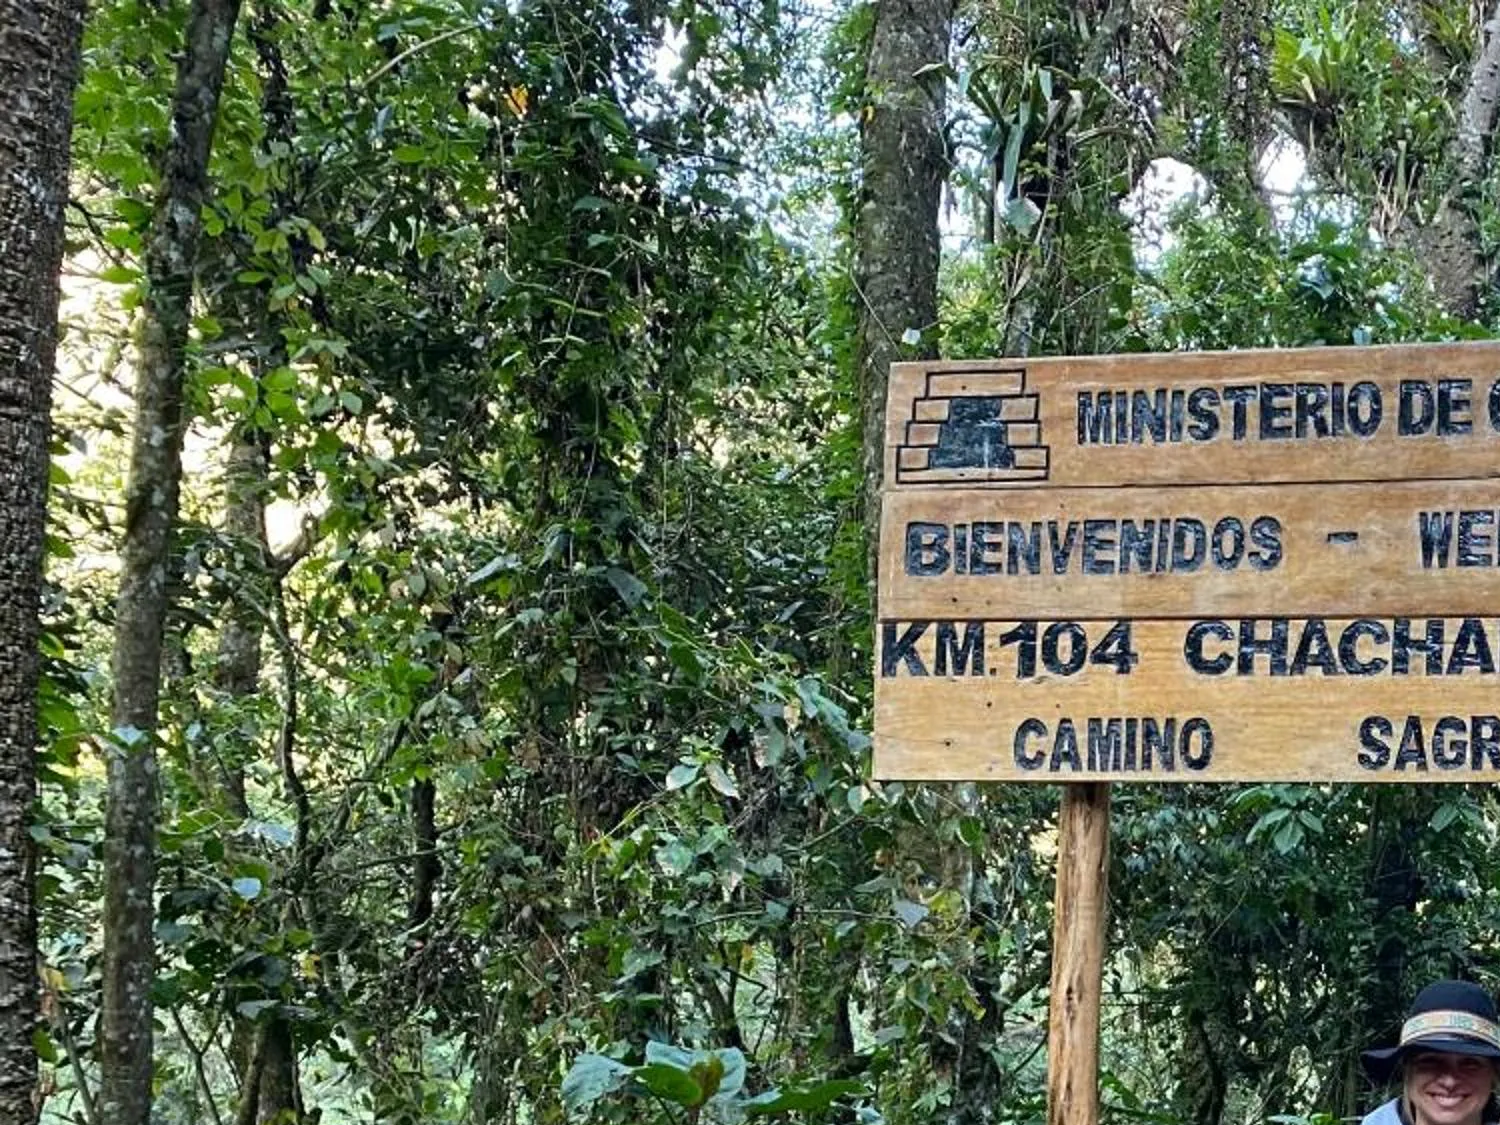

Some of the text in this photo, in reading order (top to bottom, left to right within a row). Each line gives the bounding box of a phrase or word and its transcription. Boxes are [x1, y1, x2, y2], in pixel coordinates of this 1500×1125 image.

[1077, 381, 1382, 444] MINISTERIO
[1399, 378, 1473, 437] DE
[905, 515, 1283, 576] BIENVENIDOS
[1014, 717, 1214, 772] CAMINO
